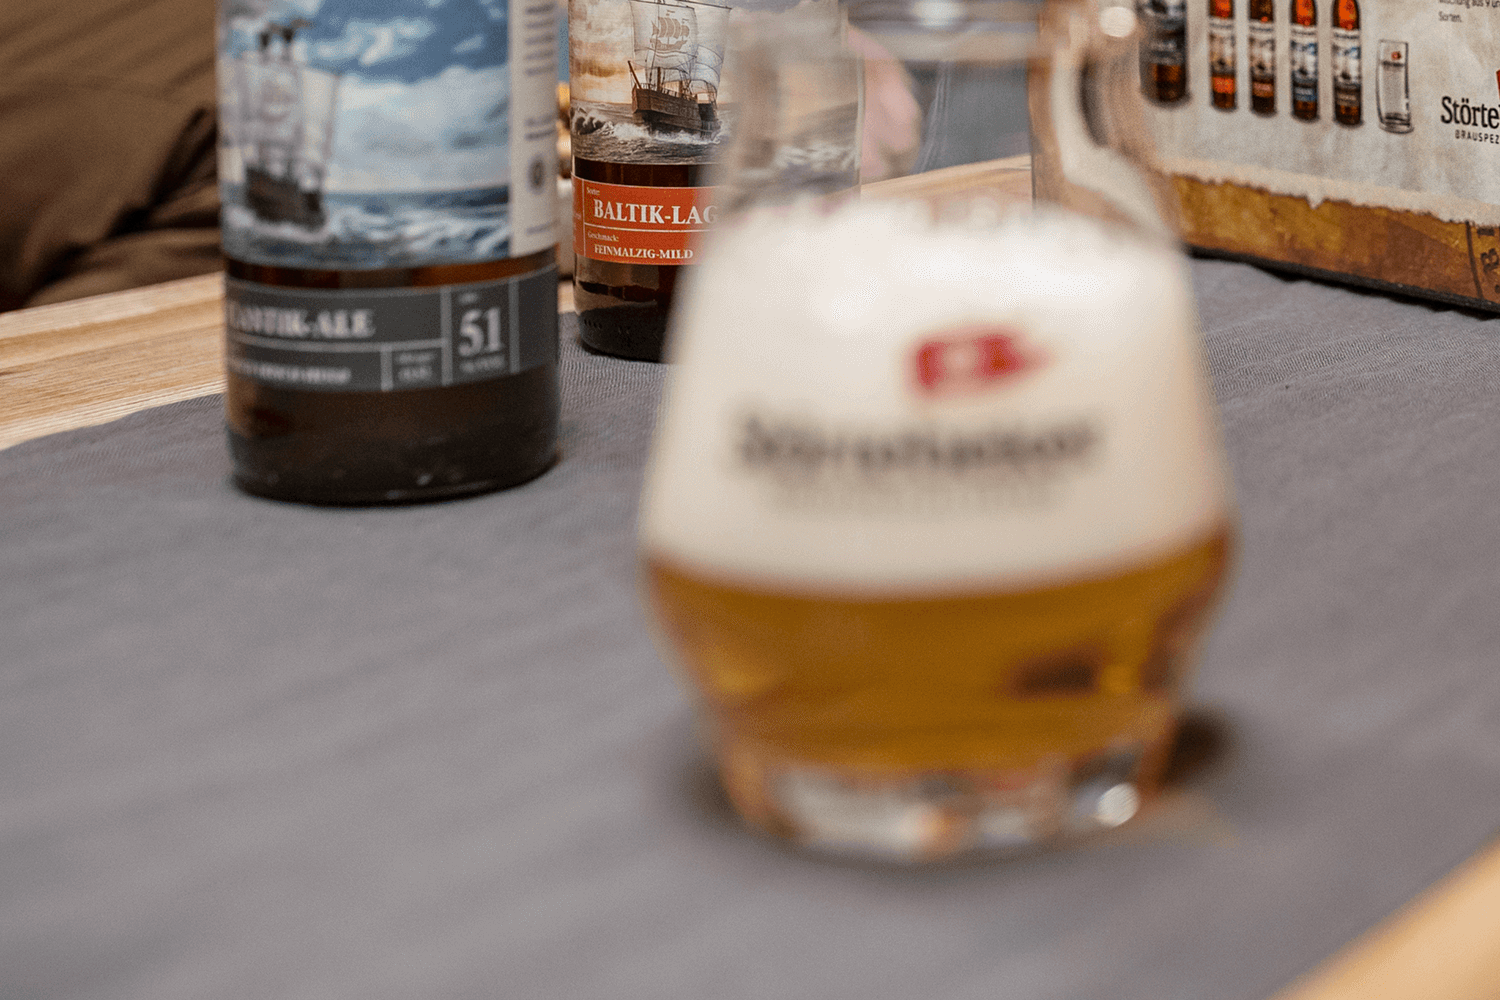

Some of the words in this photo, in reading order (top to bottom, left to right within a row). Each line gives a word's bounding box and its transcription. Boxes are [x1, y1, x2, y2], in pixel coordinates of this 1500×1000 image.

[593, 198, 719, 225] BALTIK-LAG
[587, 231, 619, 242] Geschmack:
[594, 243, 694, 259] FEINMALZIG-MILD
[458, 306, 504, 357] 51
